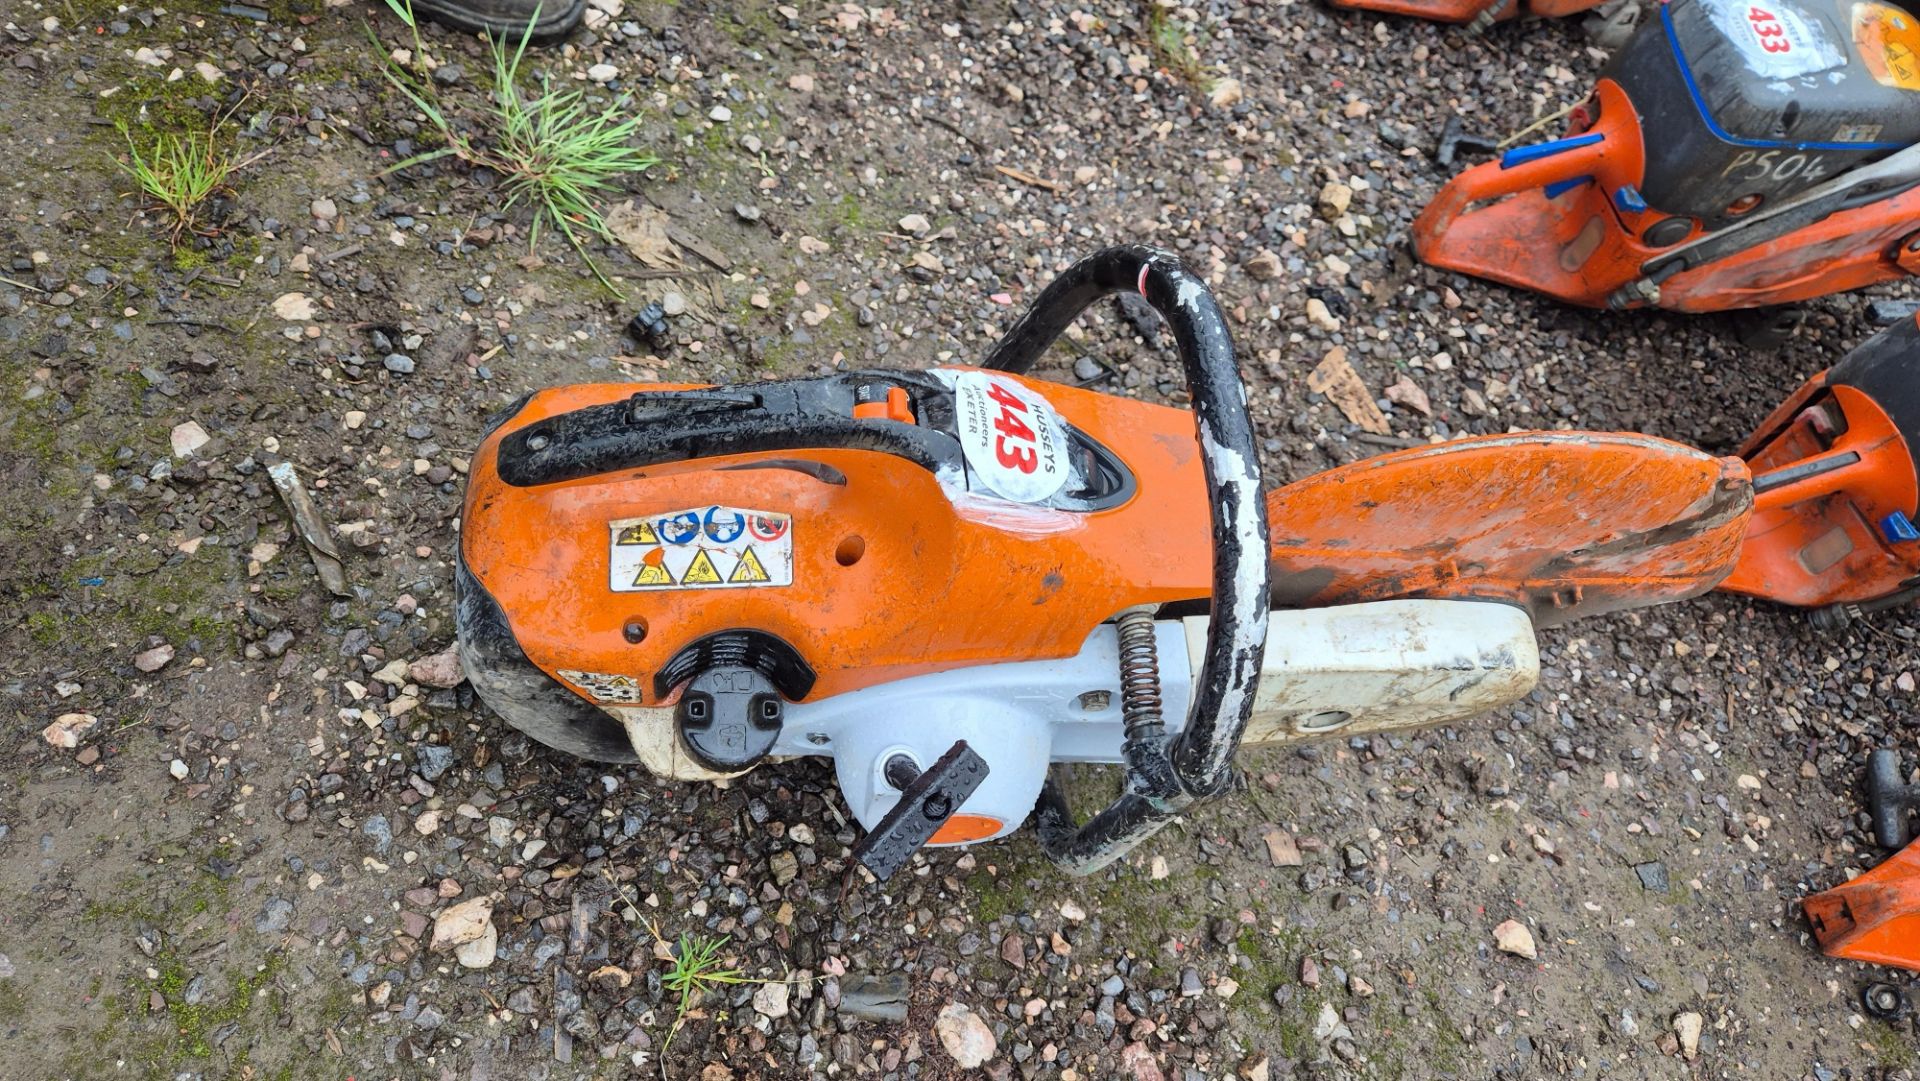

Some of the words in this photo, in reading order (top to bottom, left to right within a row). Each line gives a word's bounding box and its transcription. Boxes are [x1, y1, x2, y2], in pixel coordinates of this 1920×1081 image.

[1749, 7, 1790, 53] 433
[962, 386, 978, 434] EXETER
[986, 382, 1039, 475] 443
[1031, 403, 1056, 474] HUSSEYS
